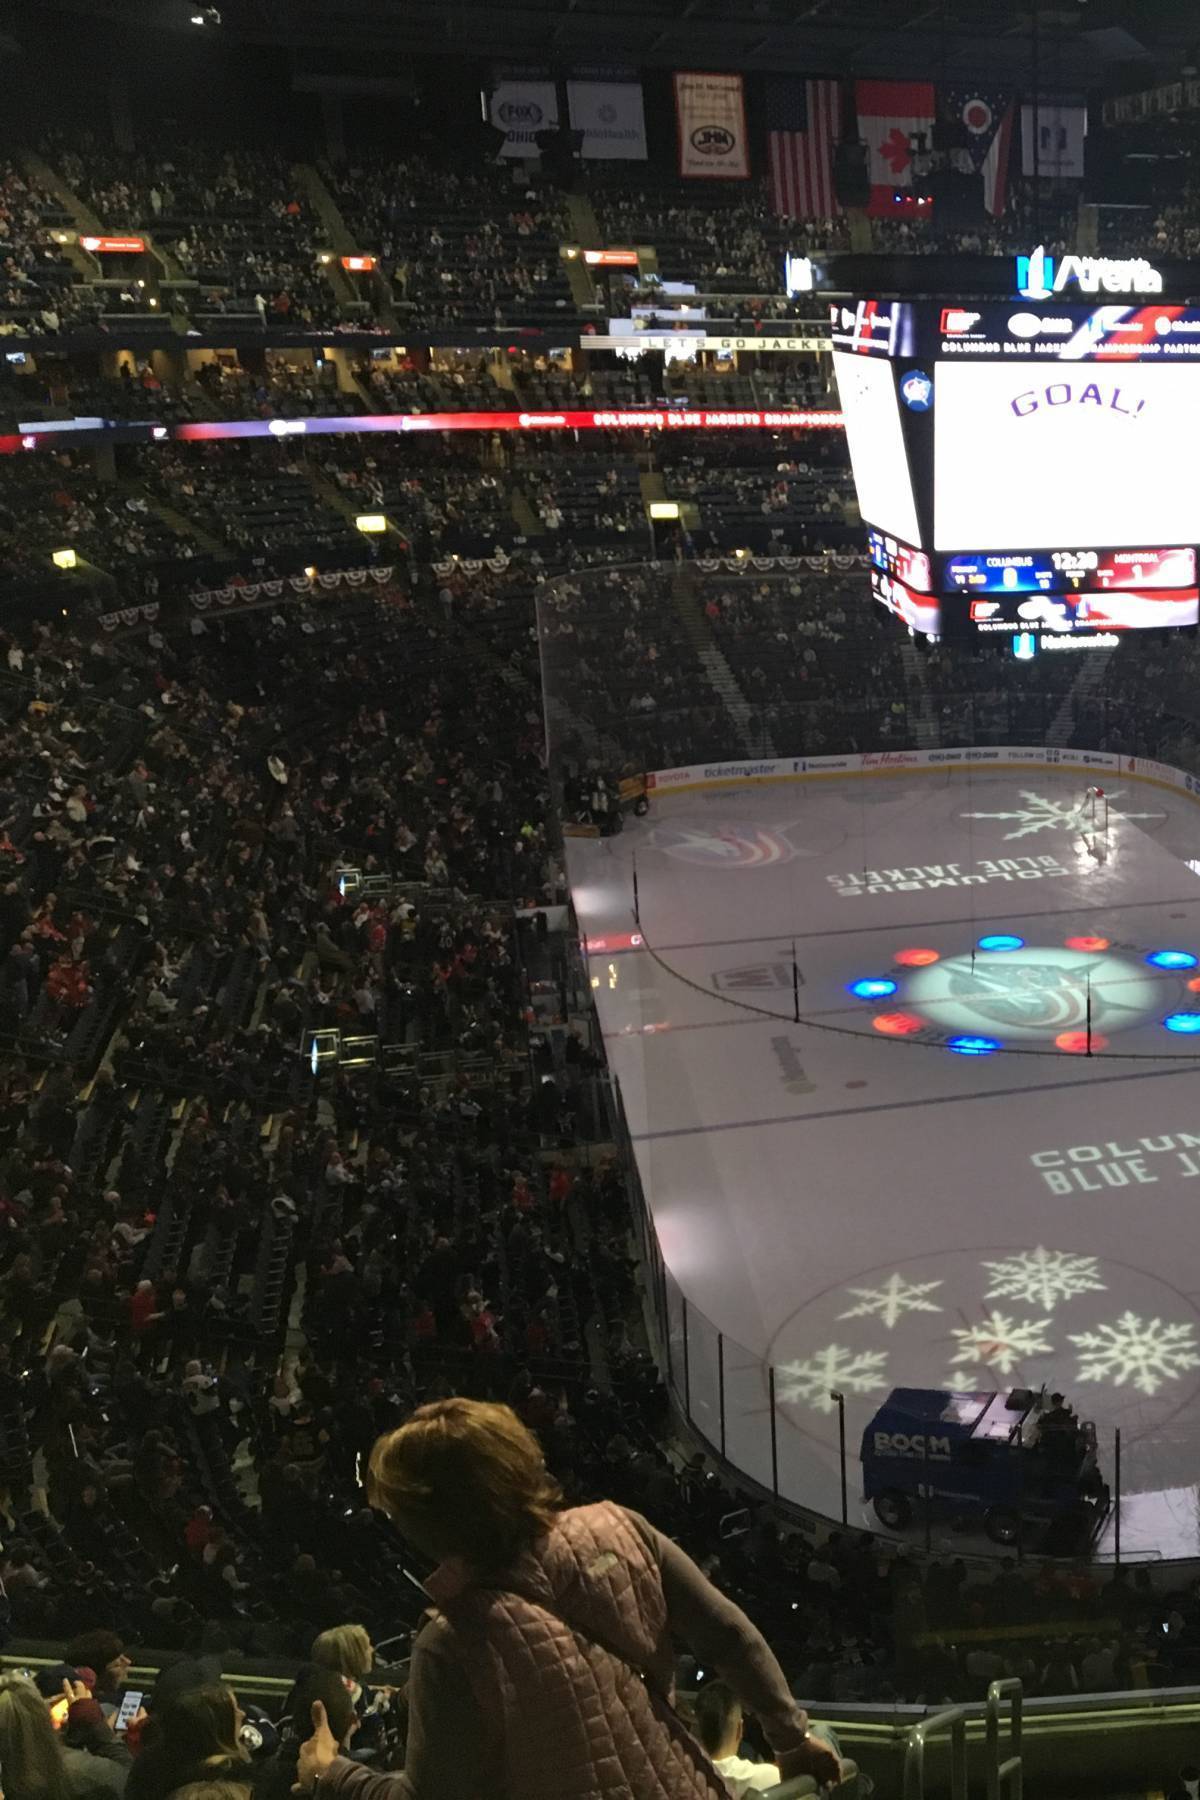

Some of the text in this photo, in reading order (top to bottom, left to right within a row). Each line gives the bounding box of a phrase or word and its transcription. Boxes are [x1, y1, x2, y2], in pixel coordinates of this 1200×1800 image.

[1053, 255, 1163, 293] Arena
[721, 338, 746, 348] GO
[1010, 383, 1145, 418] GOAL!
[986, 556, 1034, 568] COLUMBUS
[1040, 633, 1120, 650] Nationwide
[658, 772, 691, 784] TOYOTA
[703, 763, 776, 779] ticketmaster
[825, 855, 1060, 888] BLUE JACKETS
[836, 867, 1072, 897] COLUMBUS
[1042, 1158, 1159, 1196] BLUE
